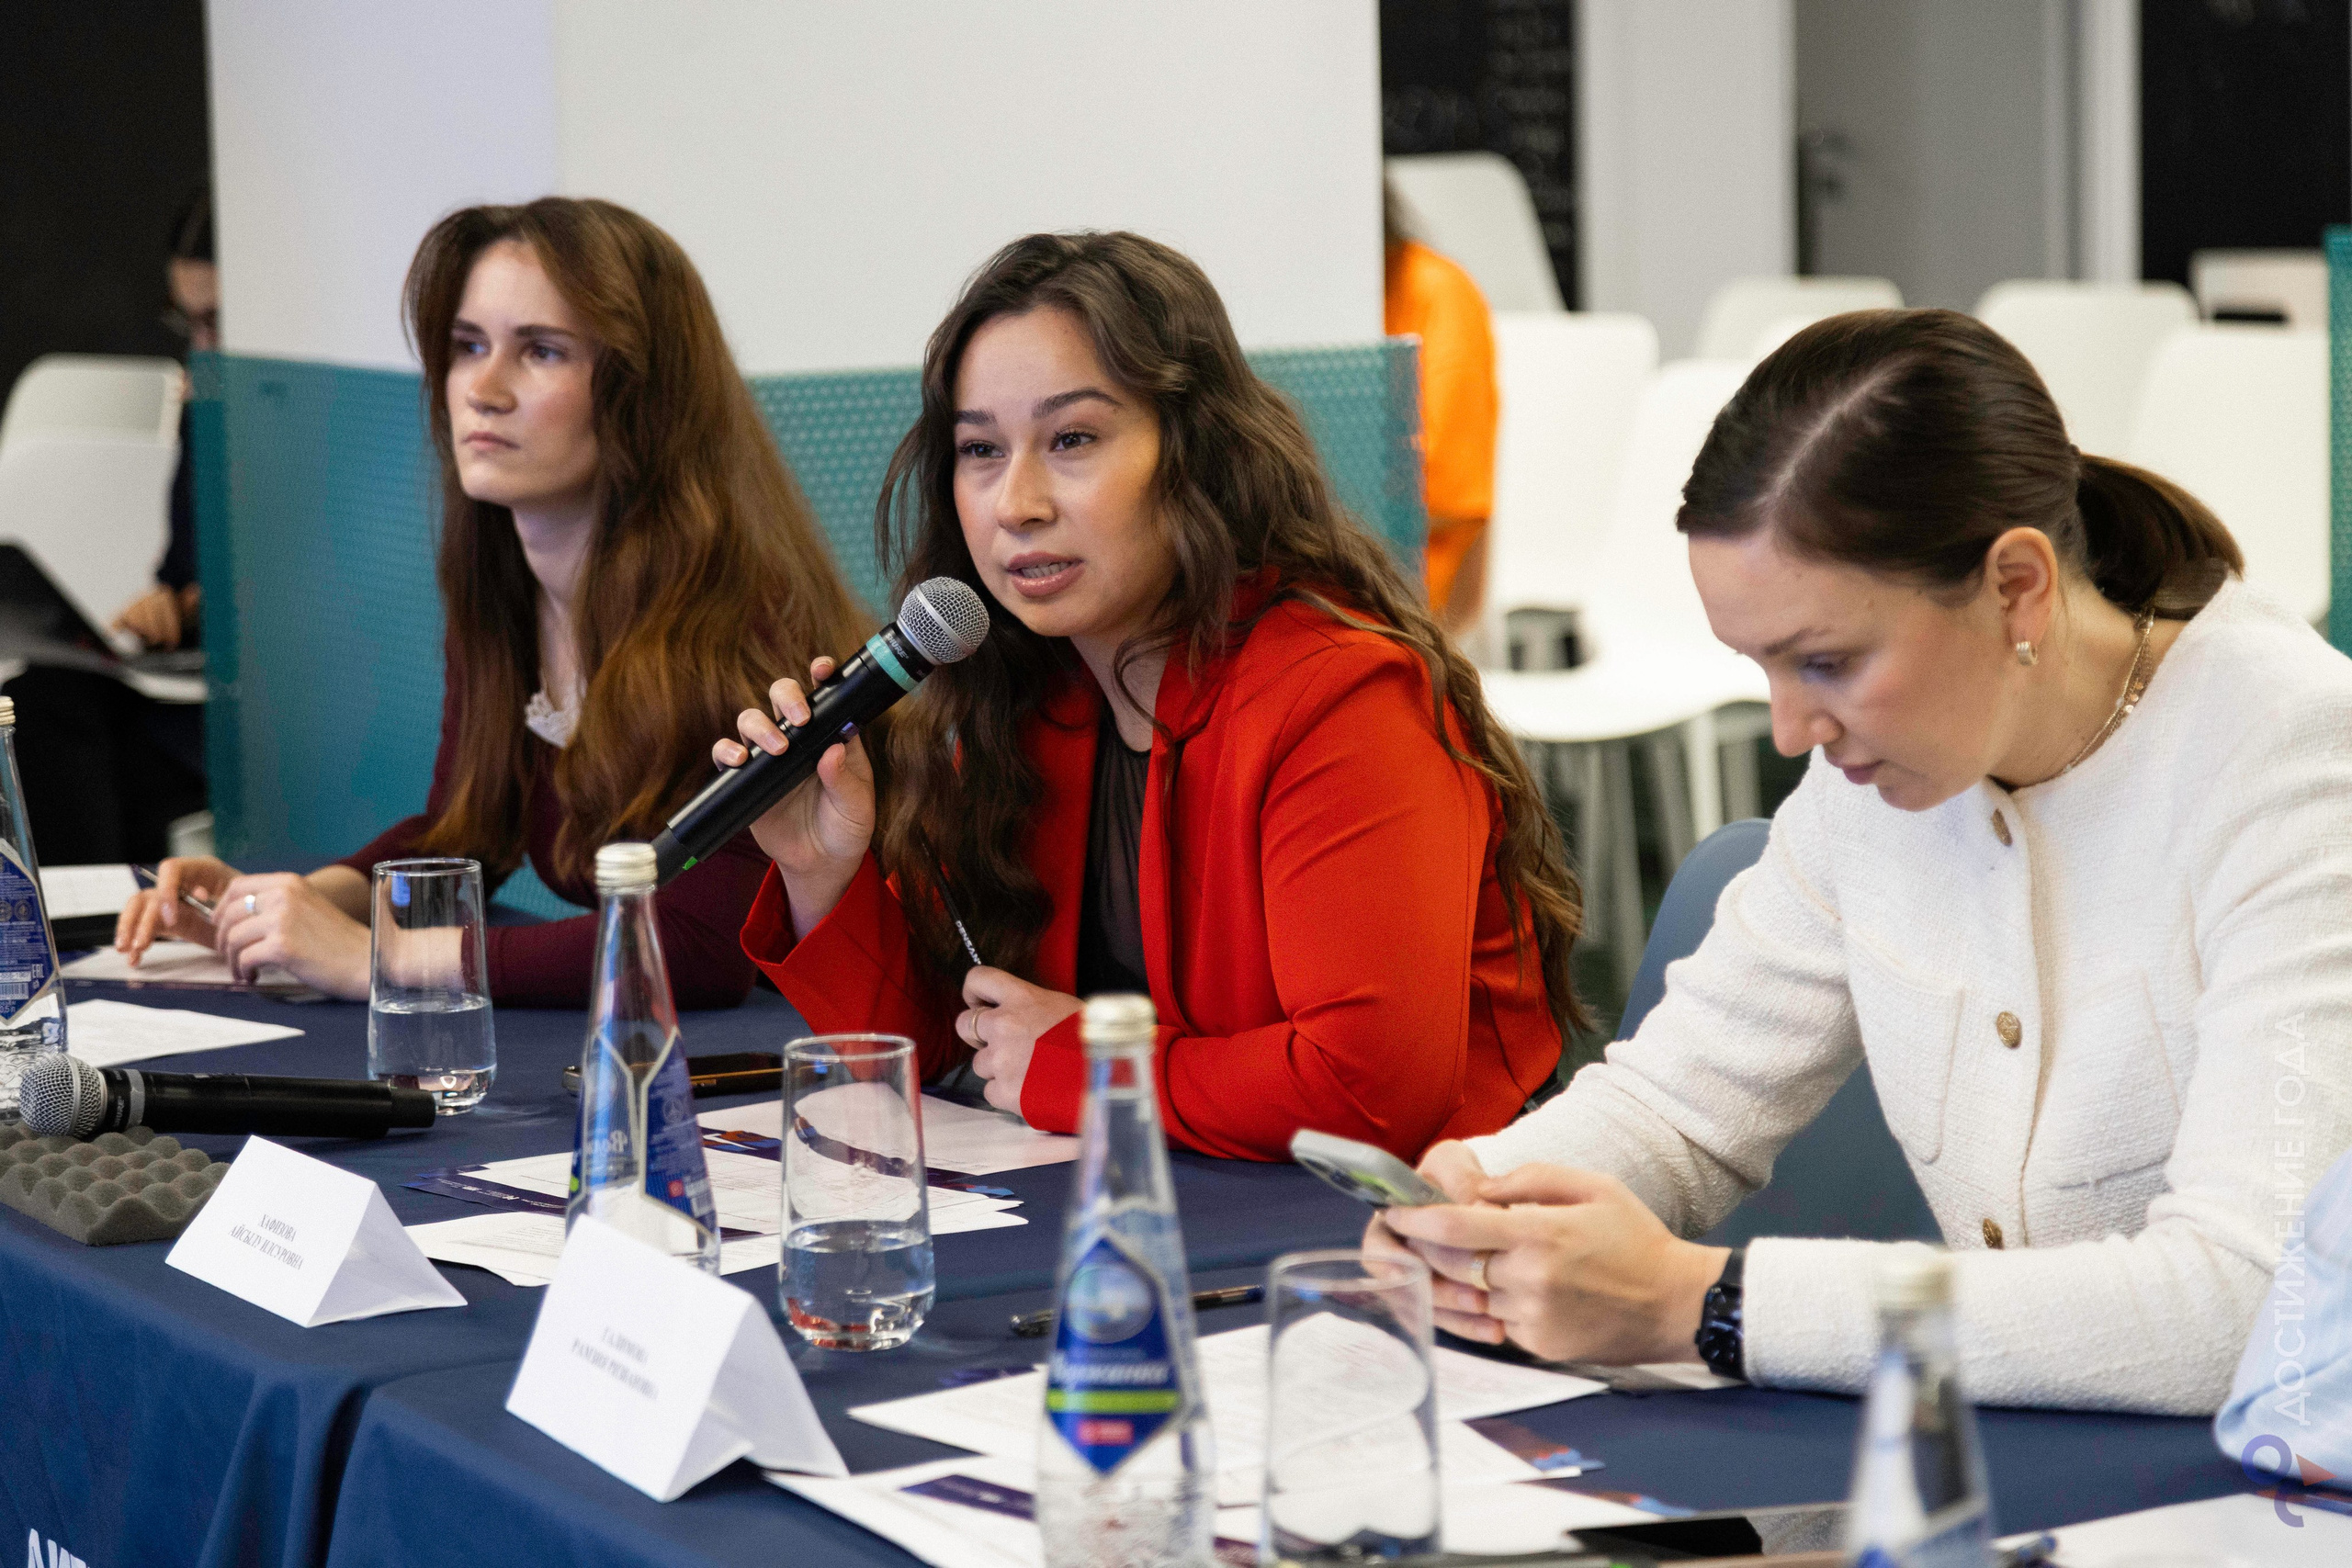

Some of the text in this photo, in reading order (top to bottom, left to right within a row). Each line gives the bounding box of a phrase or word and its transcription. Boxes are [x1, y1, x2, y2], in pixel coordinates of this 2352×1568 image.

[885, 631, 908, 659] SHURE
[258, 1213, 298, 1242] ХАФИЗОВА
[228, 1224, 304, 1270] АЙСЫЛУ ИЛСУРОВНА
